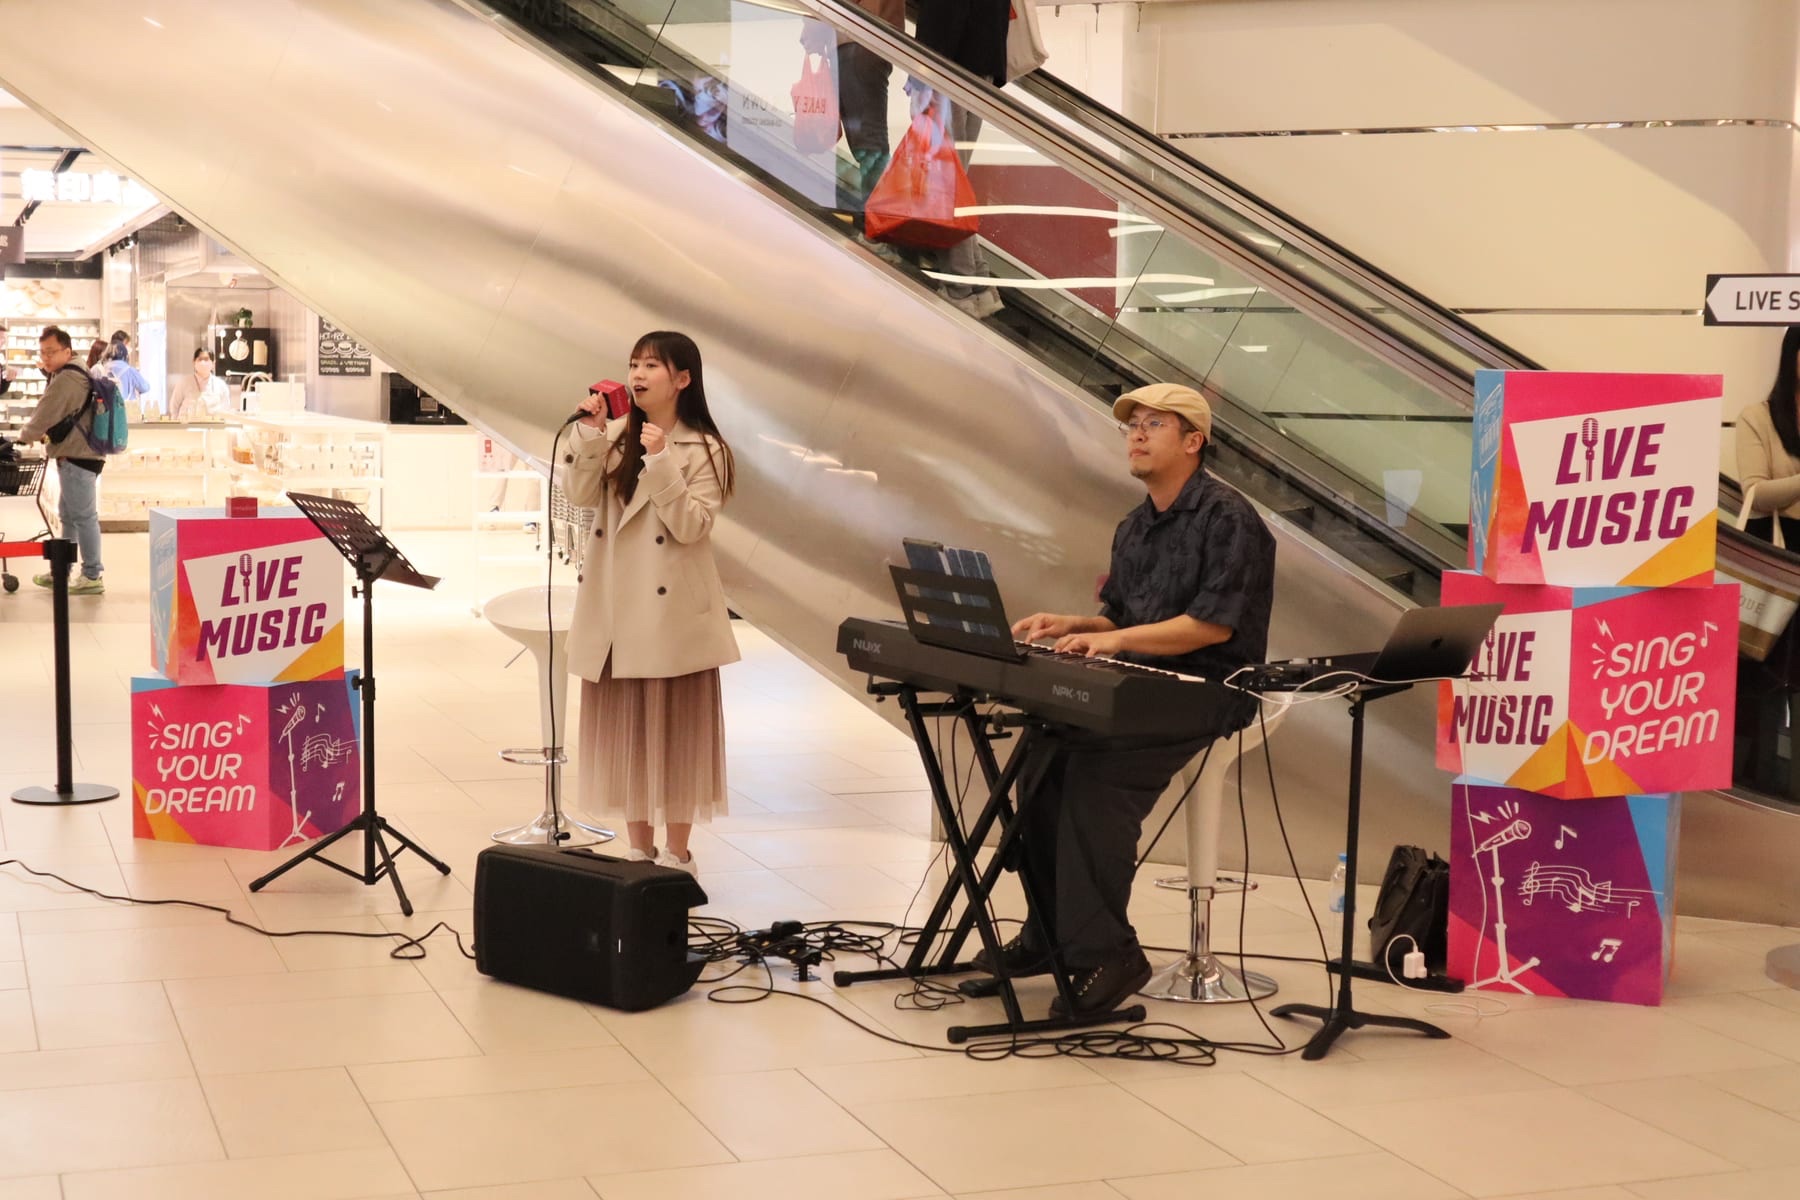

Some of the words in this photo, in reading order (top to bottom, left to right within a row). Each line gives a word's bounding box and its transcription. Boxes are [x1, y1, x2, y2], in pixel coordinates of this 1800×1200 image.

[1735, 290, 1782, 310] LIVE
[1555, 417, 1665, 485] LIVE
[1520, 485, 1695, 554] MUSIC
[221, 553, 303, 607] LIVE
[195, 602, 327, 662] MUSIC
[1606, 631, 1697, 678] SING
[1052, 684, 1089, 702] NPK-10
[1601, 671, 1705, 720] YOUR
[161, 720, 233, 750] SING
[1448, 695, 1553, 746] MUSIC
[1582, 708, 1720, 765] DREAM
[156, 754, 242, 783] YOUR
[144, 784, 256, 815] DREAM
